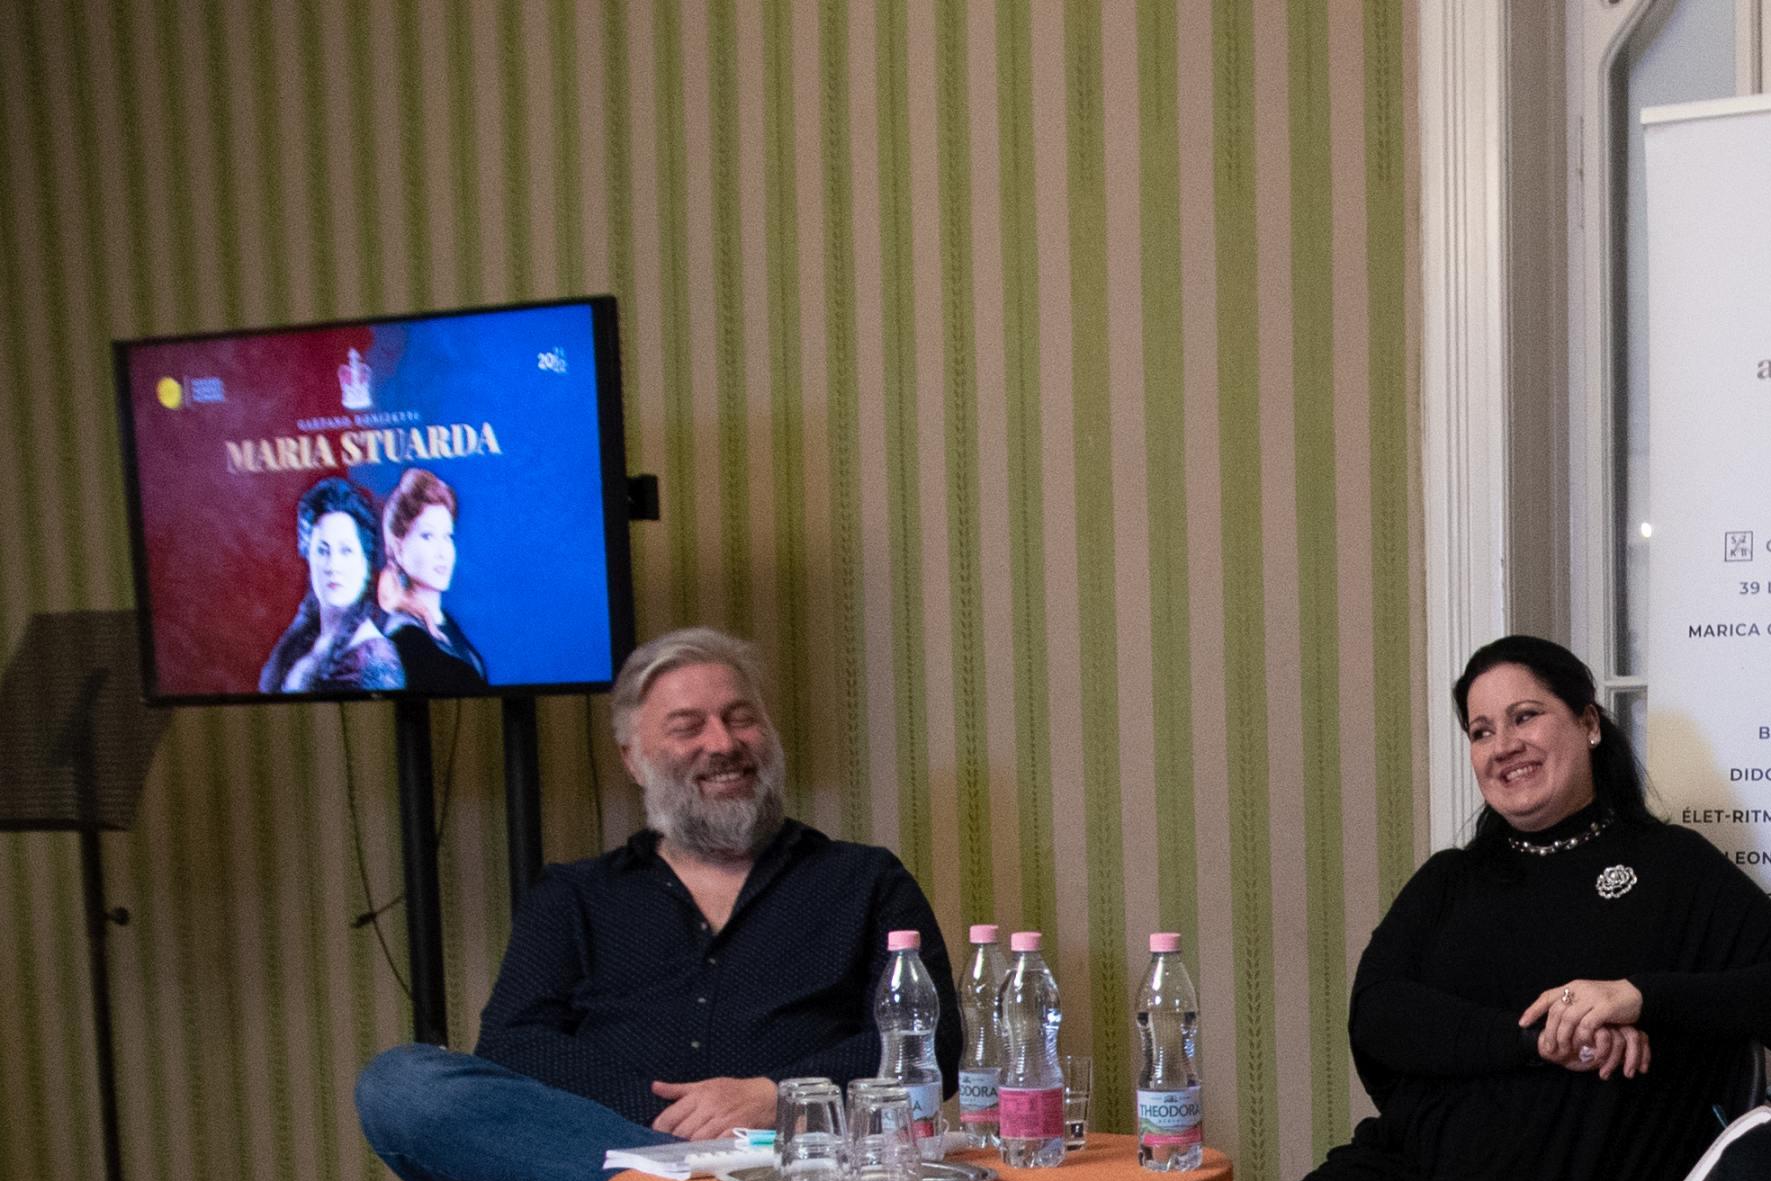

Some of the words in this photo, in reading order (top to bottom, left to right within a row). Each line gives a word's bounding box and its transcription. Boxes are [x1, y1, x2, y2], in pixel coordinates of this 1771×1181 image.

[225, 433, 339, 474] MARIA
[340, 421, 502, 467] STUARDA
[1739, 581, 1761, 596] 39
[1688, 623, 1761, 639] MARICA
